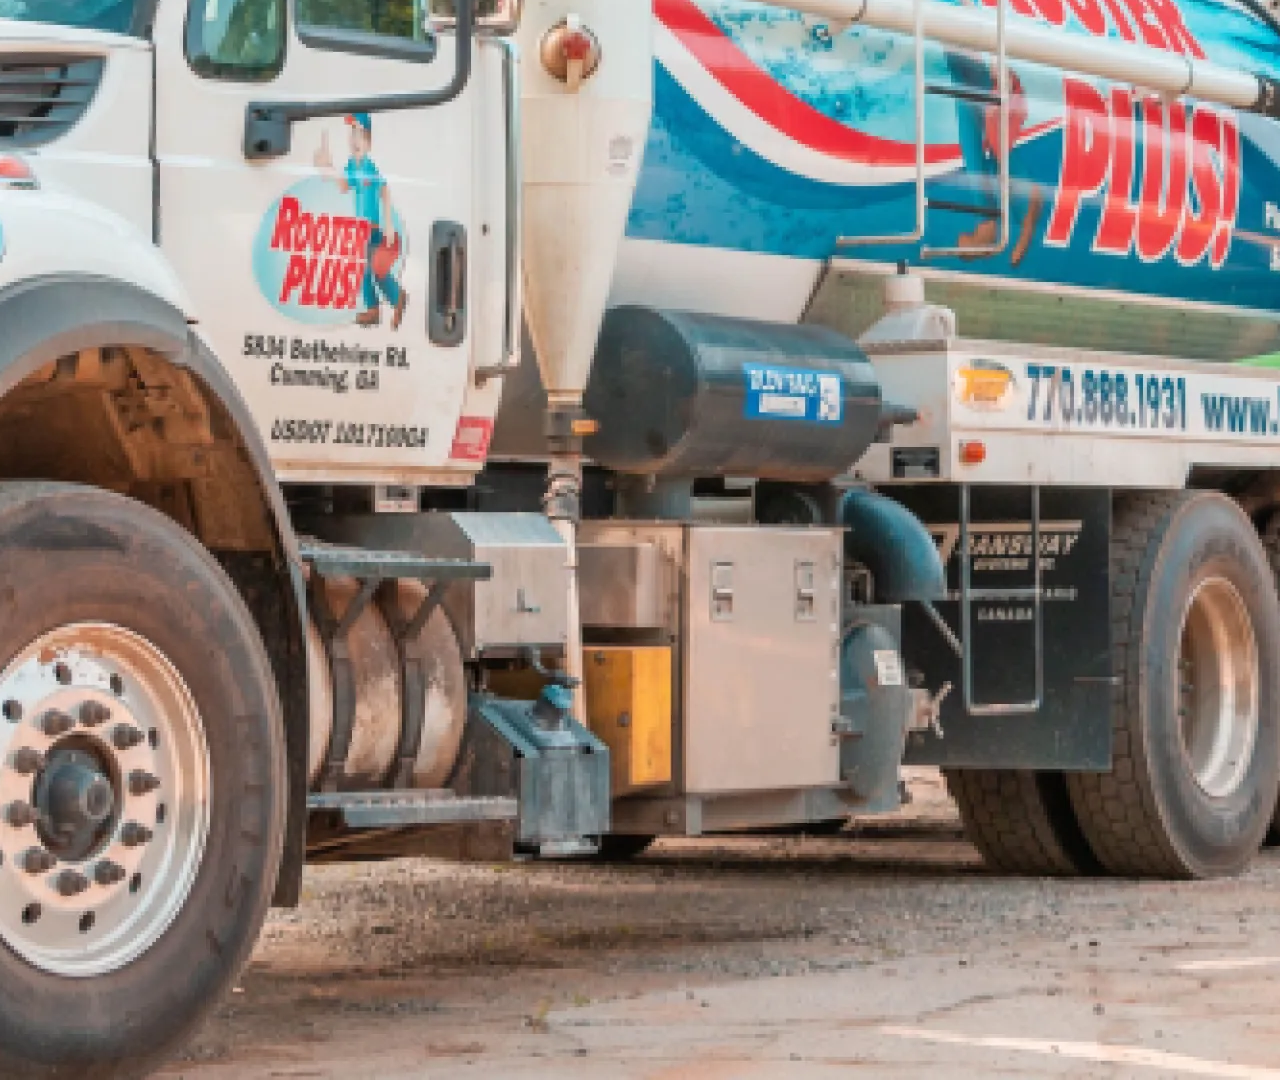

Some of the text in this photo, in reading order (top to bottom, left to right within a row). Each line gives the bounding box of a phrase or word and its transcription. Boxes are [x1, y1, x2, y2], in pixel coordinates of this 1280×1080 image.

[1043, 77, 1241, 270] PLUS!
[269, 195, 371, 261] ROOTER
[243, 335, 286, 360] 5834
[1024, 364, 1187, 431] 770.888.1931
[271, 418, 332, 444] USDOT
